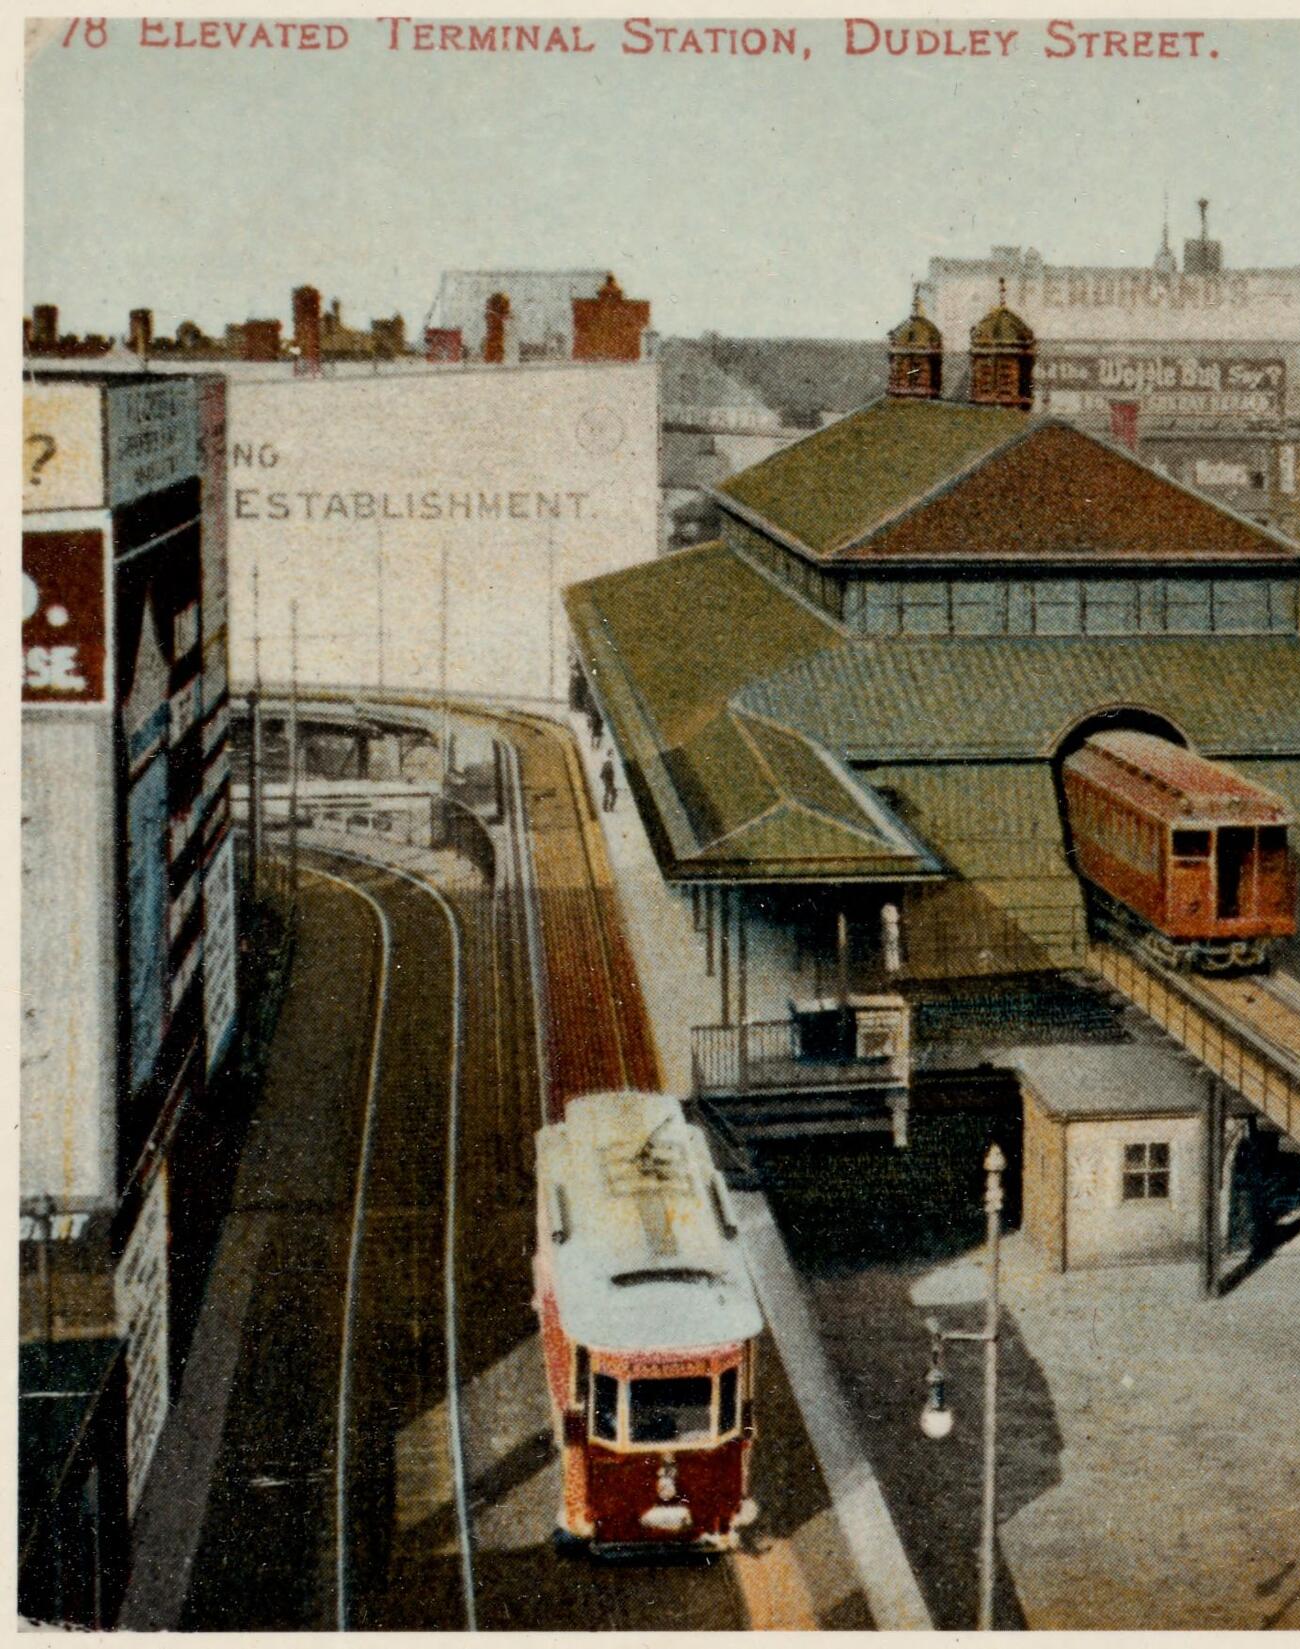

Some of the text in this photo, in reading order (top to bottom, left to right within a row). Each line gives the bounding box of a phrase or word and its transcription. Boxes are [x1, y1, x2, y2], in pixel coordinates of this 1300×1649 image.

[1098, 357, 1177, 394] Woggle
[1179, 358, 1223, 391] Bug
[231, 442, 280, 469] NG
[234, 488, 600, 521] ESTABLISHMENT.
[27, 644, 87, 692] SE
